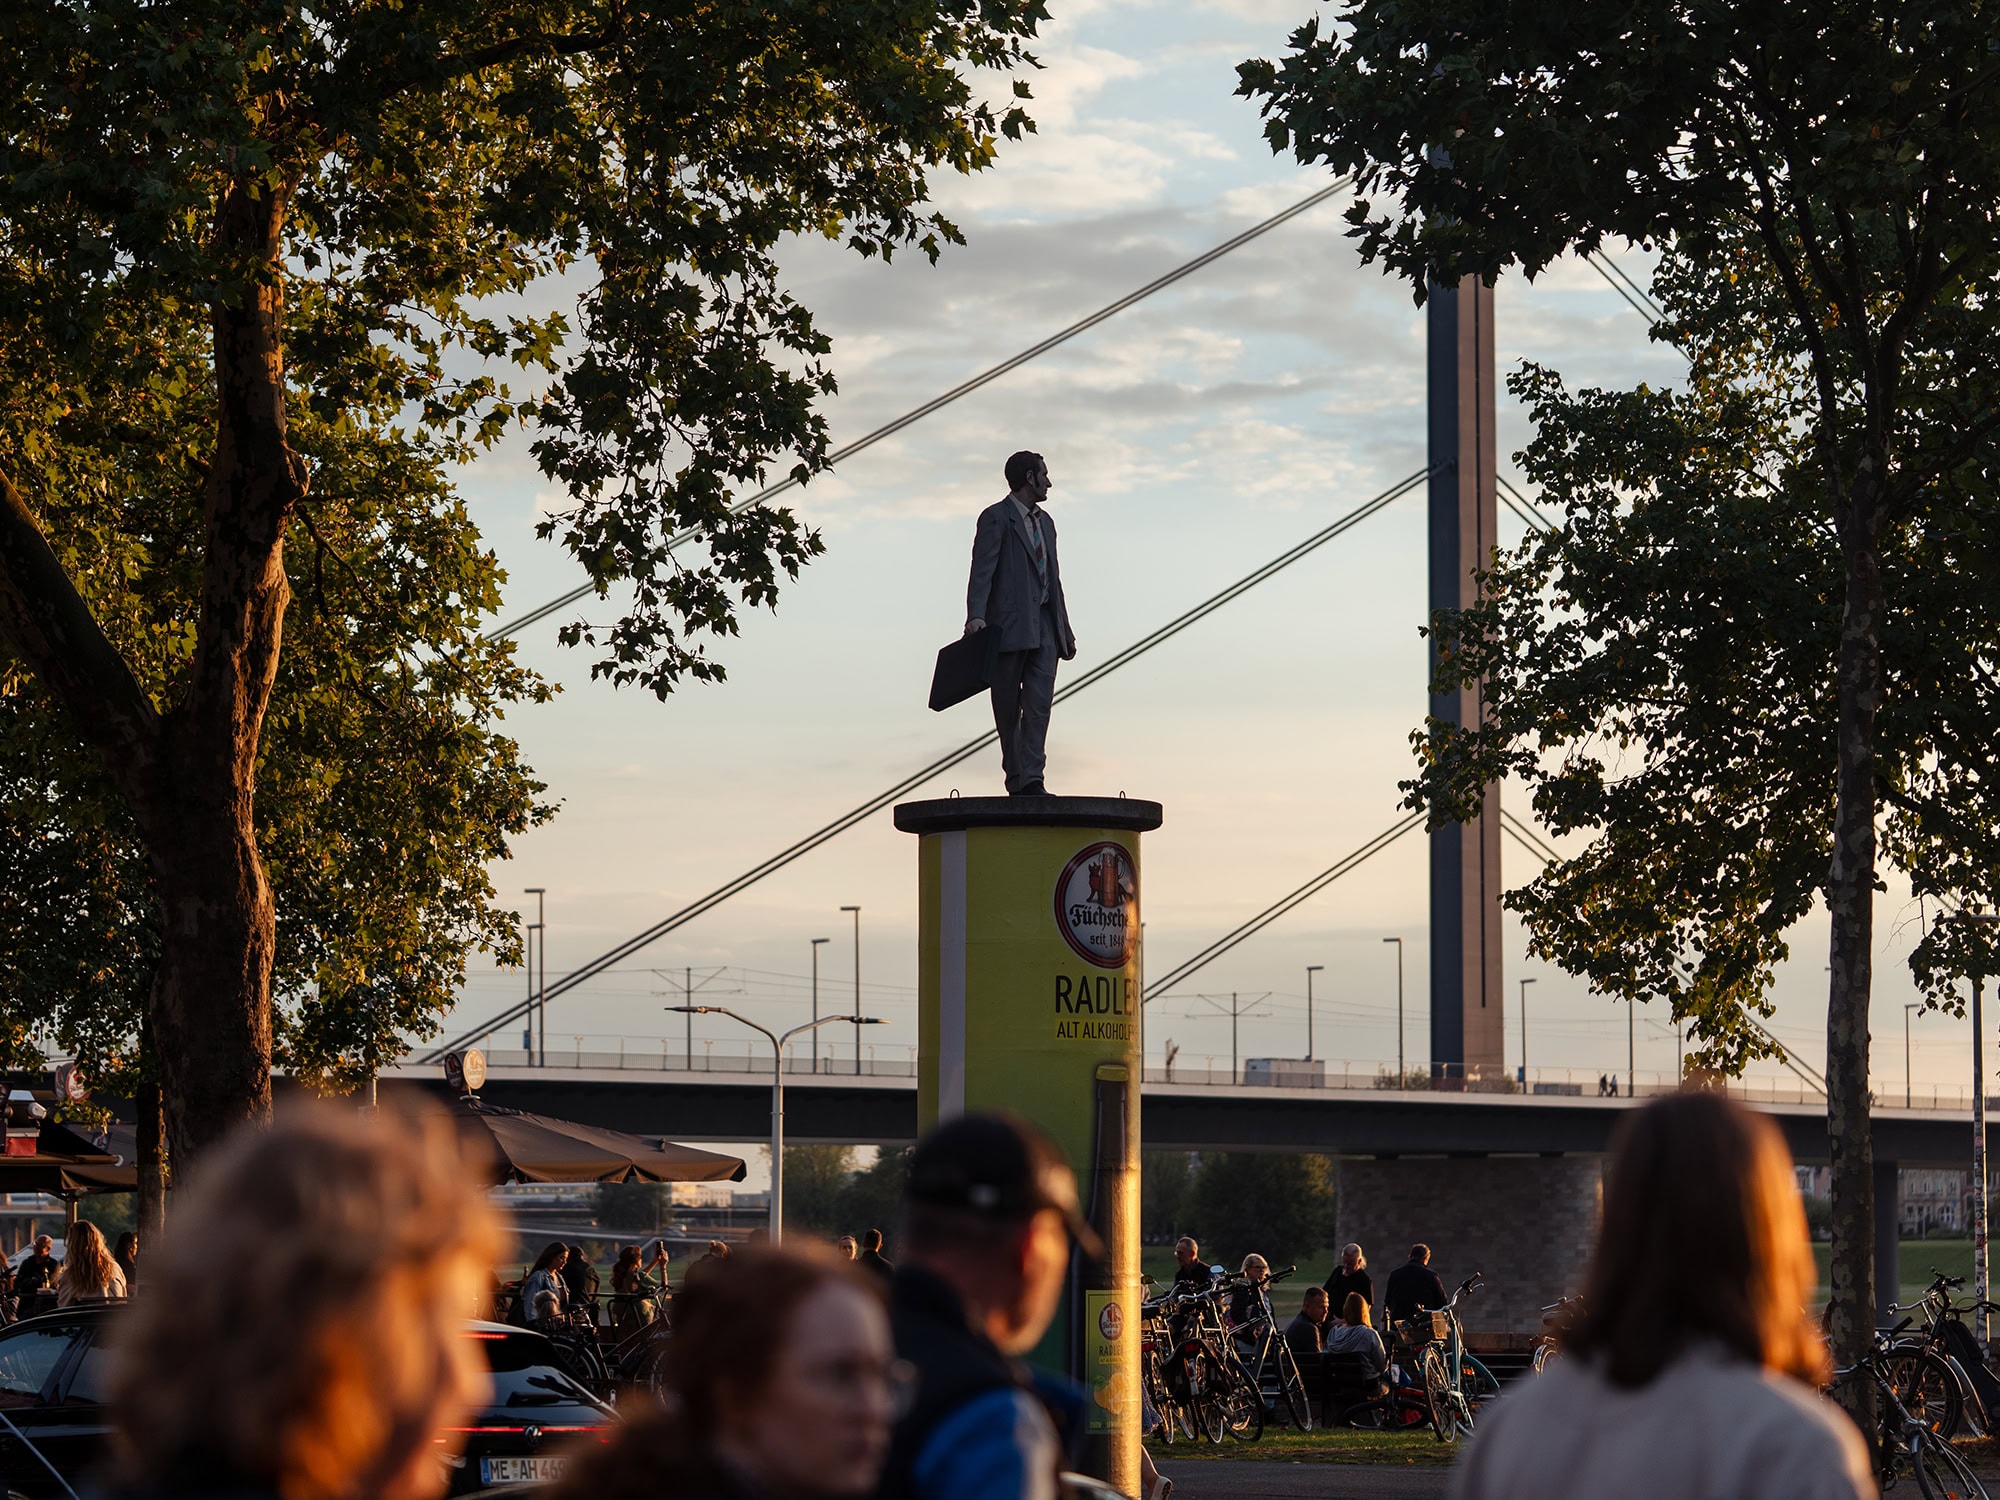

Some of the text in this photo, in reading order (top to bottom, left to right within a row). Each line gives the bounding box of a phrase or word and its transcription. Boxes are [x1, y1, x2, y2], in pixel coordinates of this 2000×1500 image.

[1055, 975, 1139, 1017] RADLER
[1056, 1020, 1080, 1039] ALT
[489, 1460, 510, 1480] ME
[519, 1460, 538, 1480] AH
